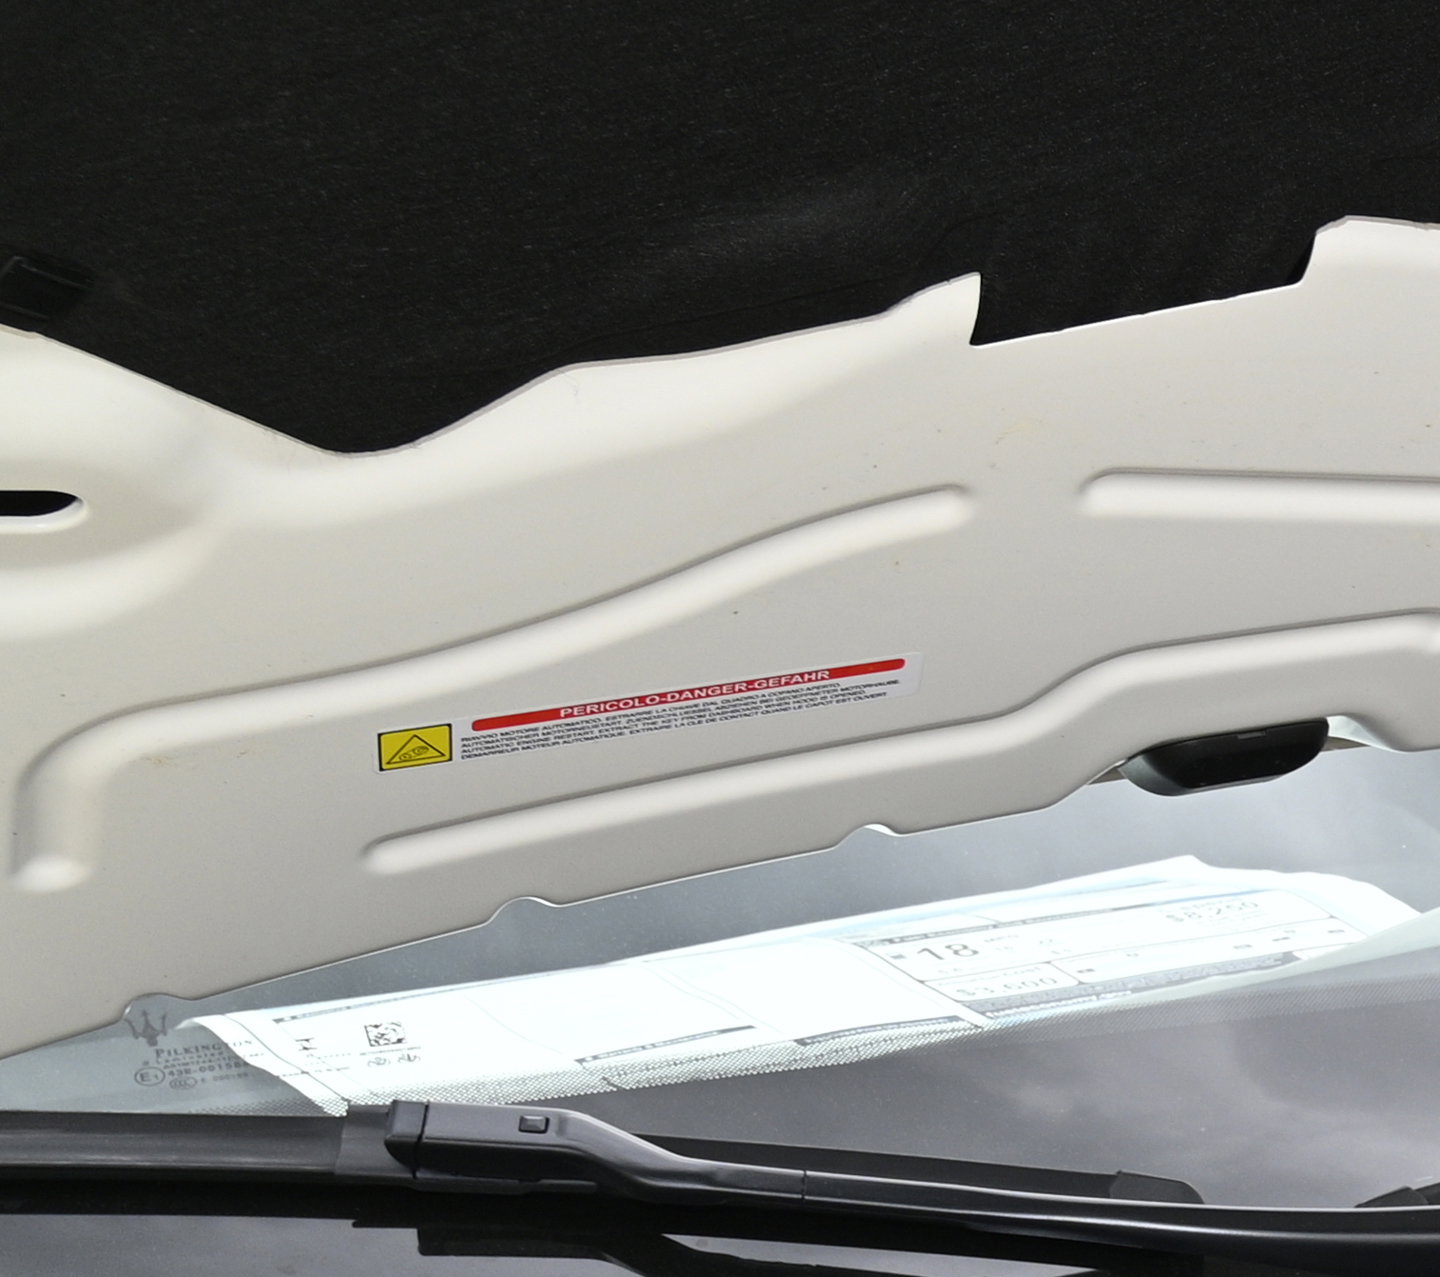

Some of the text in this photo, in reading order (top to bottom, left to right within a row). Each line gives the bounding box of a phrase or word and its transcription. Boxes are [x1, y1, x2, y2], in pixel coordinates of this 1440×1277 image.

[500, 726, 539, 736] MOTORE
[668, 703, 698, 711] CHIAVE
[720, 694, 758, 704] QUADRO
[560, 670, 829, 717] PERICOLO-DANGER-GEFAHR
[461, 741, 513, 753] AUTOMATIC
[516, 736, 550, 745] ENGINE
[598, 723, 638, 733] EXTRACT
[681, 713, 705, 721] FROM
[708, 705, 762, 717] DASHBOARD
[764, 701, 790, 709] WHEN
[792, 697, 817, 705] HOOD
[521, 740, 560, 750] MOTEUR
[719, 711, 758, 721] CONTACT
[805, 700, 832, 709] CAPOT
[916, 943, 980, 961] 18
